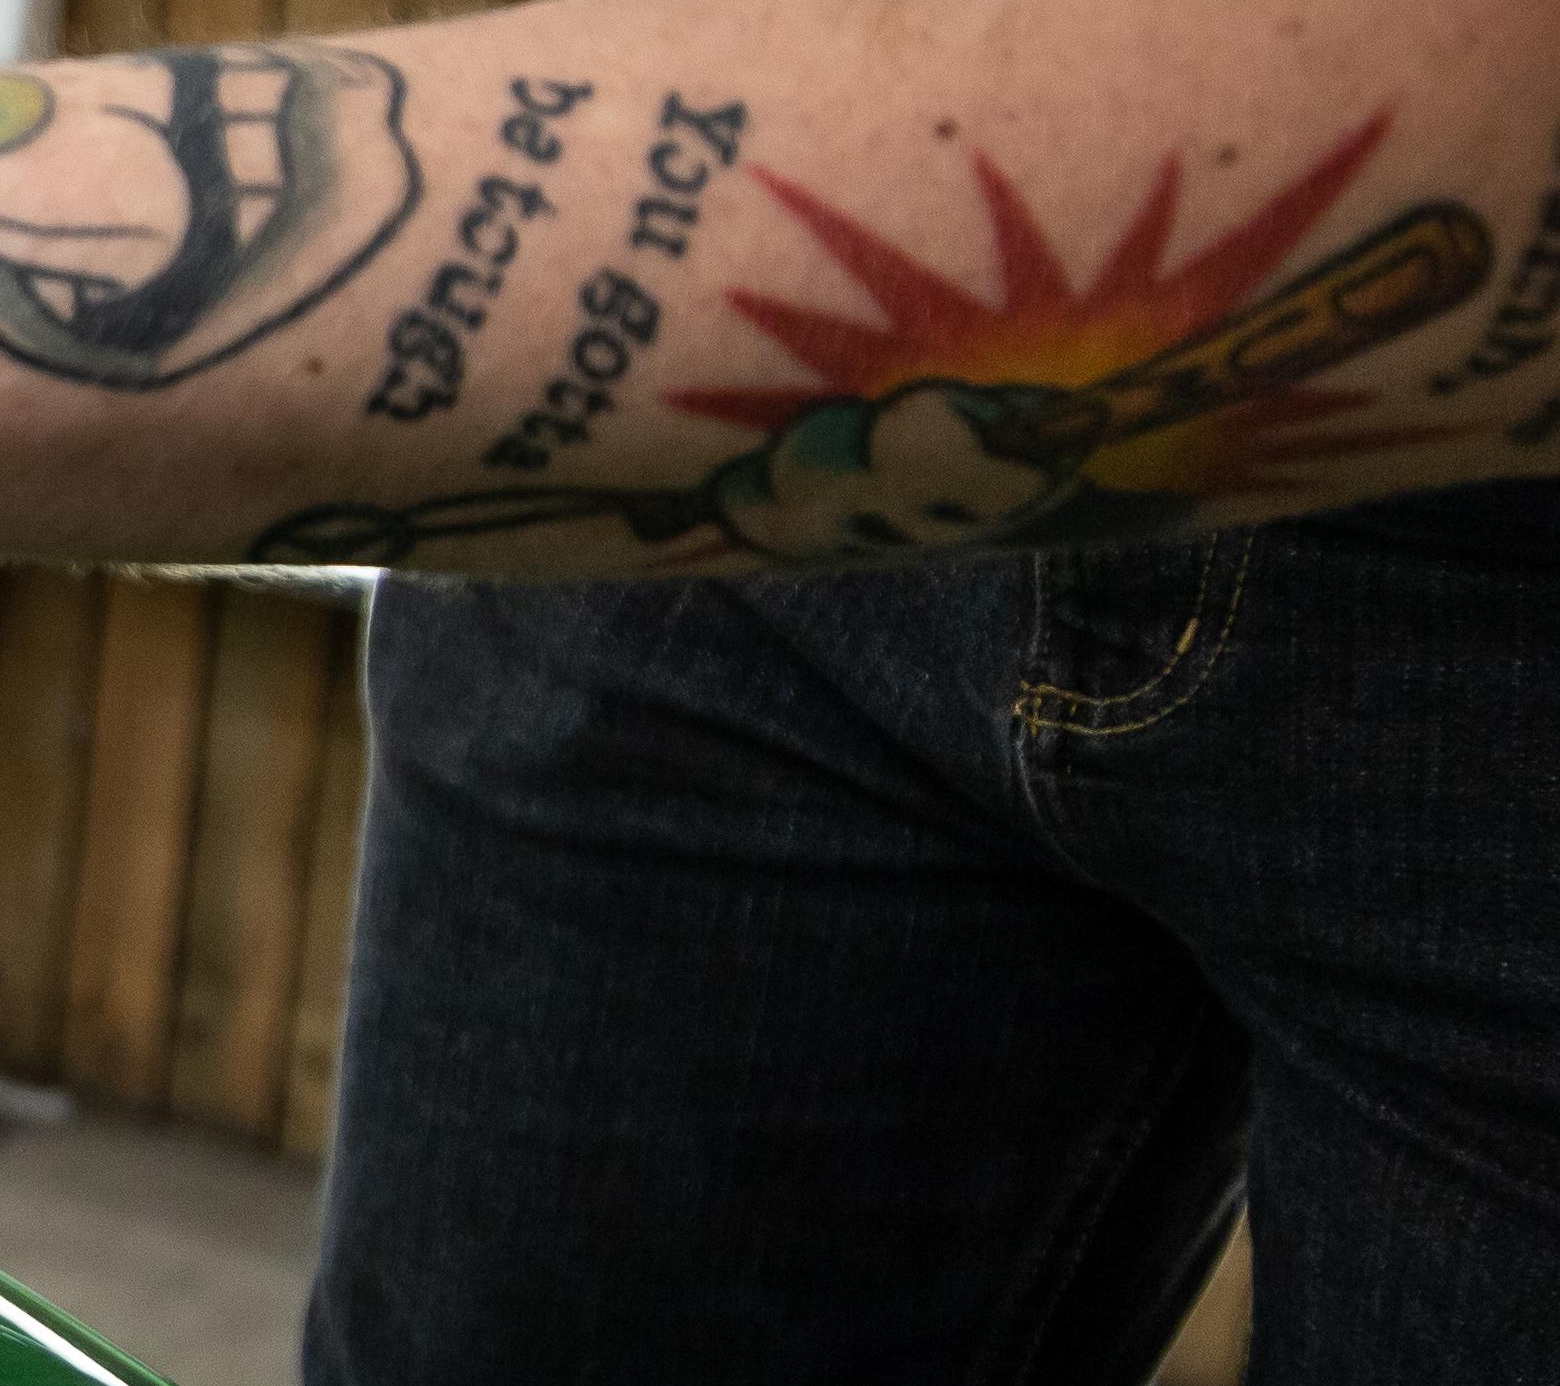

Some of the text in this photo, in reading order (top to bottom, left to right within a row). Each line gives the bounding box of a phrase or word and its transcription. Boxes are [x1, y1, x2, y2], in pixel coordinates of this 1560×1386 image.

[365, 76, 596, 423] be tough
[481, 87, 750, 472] You gotta
